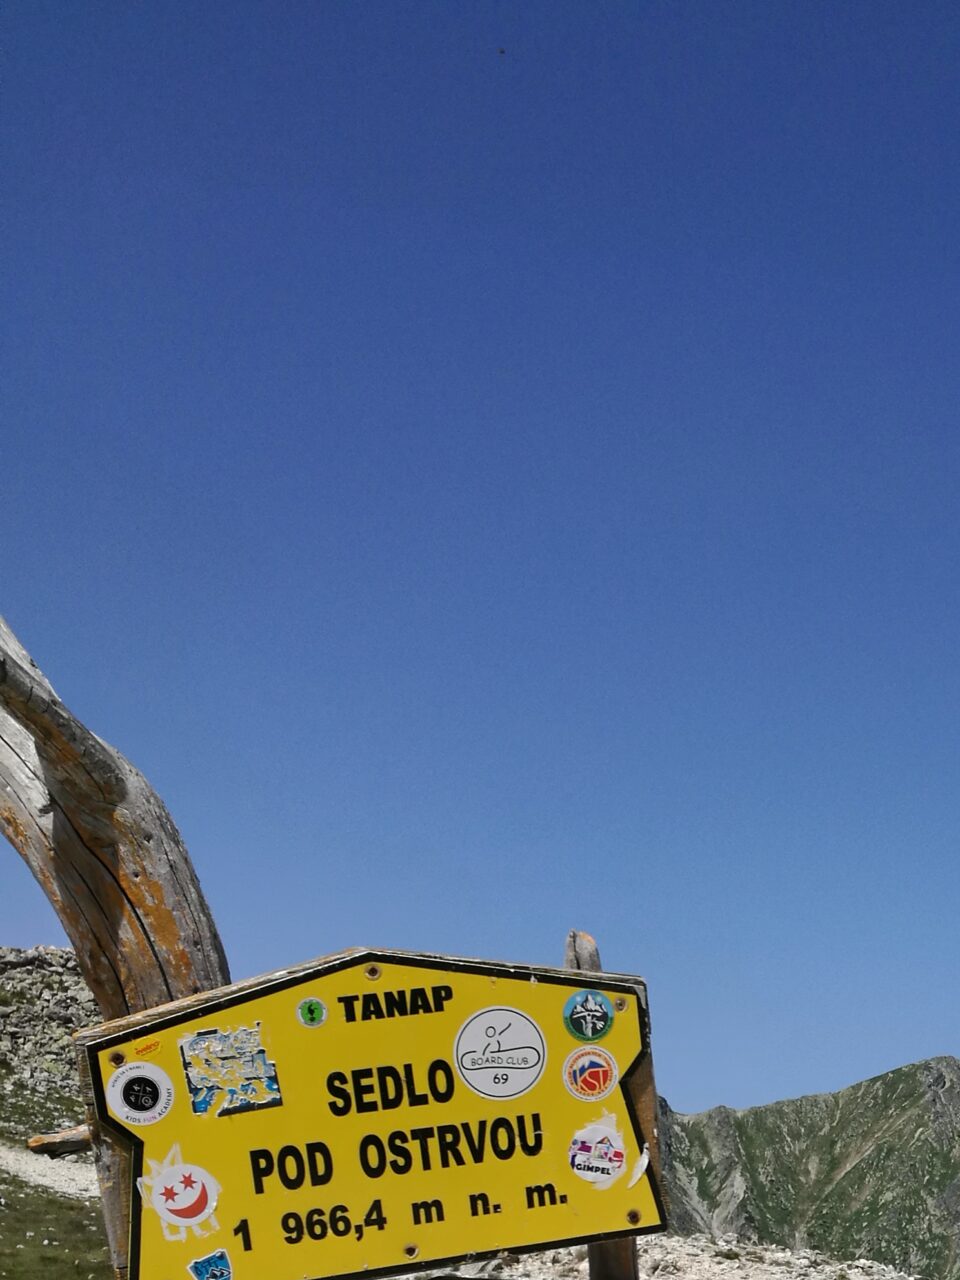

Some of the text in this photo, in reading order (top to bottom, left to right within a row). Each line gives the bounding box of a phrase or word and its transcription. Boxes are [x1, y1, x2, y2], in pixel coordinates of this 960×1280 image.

[337, 984, 454, 1023] TANAP
[471, 1056, 529, 1066] BOARD CLUB
[493, 1073, 509, 1084] 69
[326, 1059, 455, 1116] SEDLO
[250, 1113, 543, 1195] POD OSTRVOU
[576, 1163, 611, 1176] GIMPEL
[232, 1180, 568, 1252] 1 966,4 m n. m.
